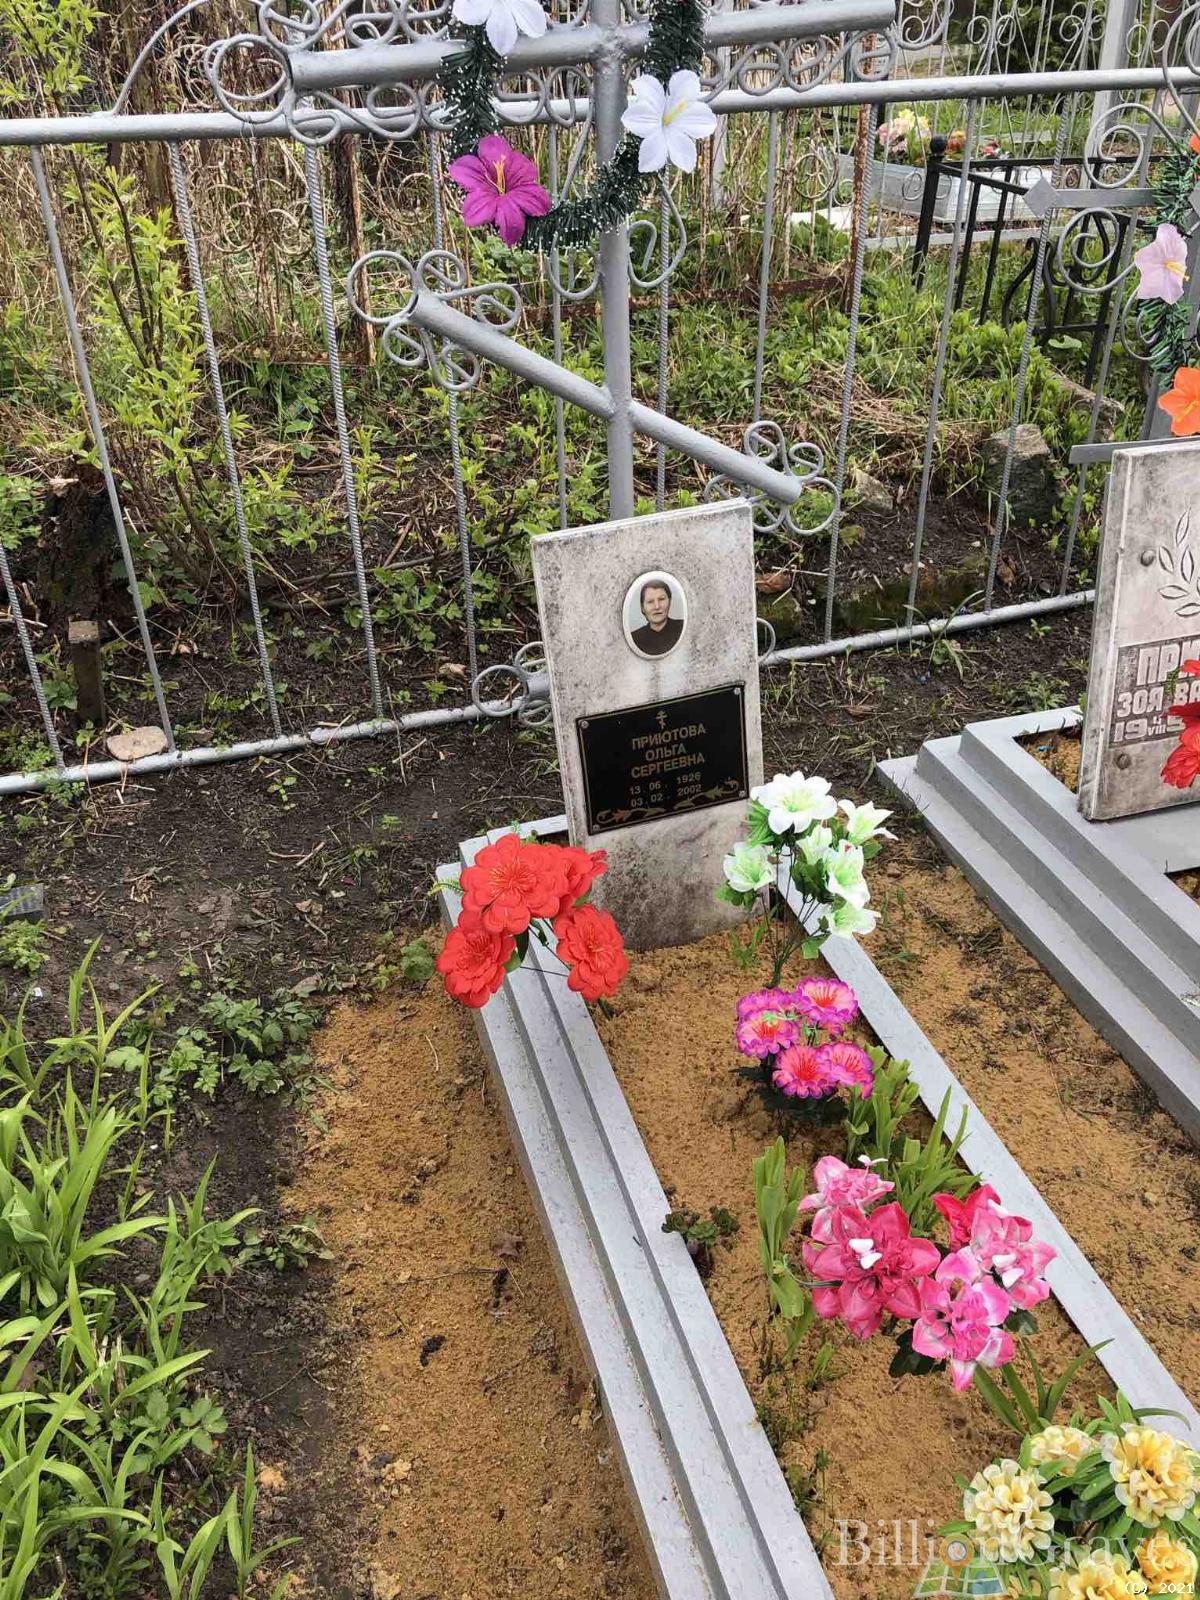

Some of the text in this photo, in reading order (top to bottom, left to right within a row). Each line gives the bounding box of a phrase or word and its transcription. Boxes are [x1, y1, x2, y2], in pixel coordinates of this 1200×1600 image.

[1116, 687, 1164, 717] ЗОЯ
[632, 723, 706, 750] ПРИЮТОВА
[1113, 718, 1148, 742] 19
[645, 743, 687, 761] ОЛЬГА
[631, 752, 705, 778] СЕРГЕЕВНА
[677, 772, 701, 784] 1926
[677, 784, 702, 796] 2002
